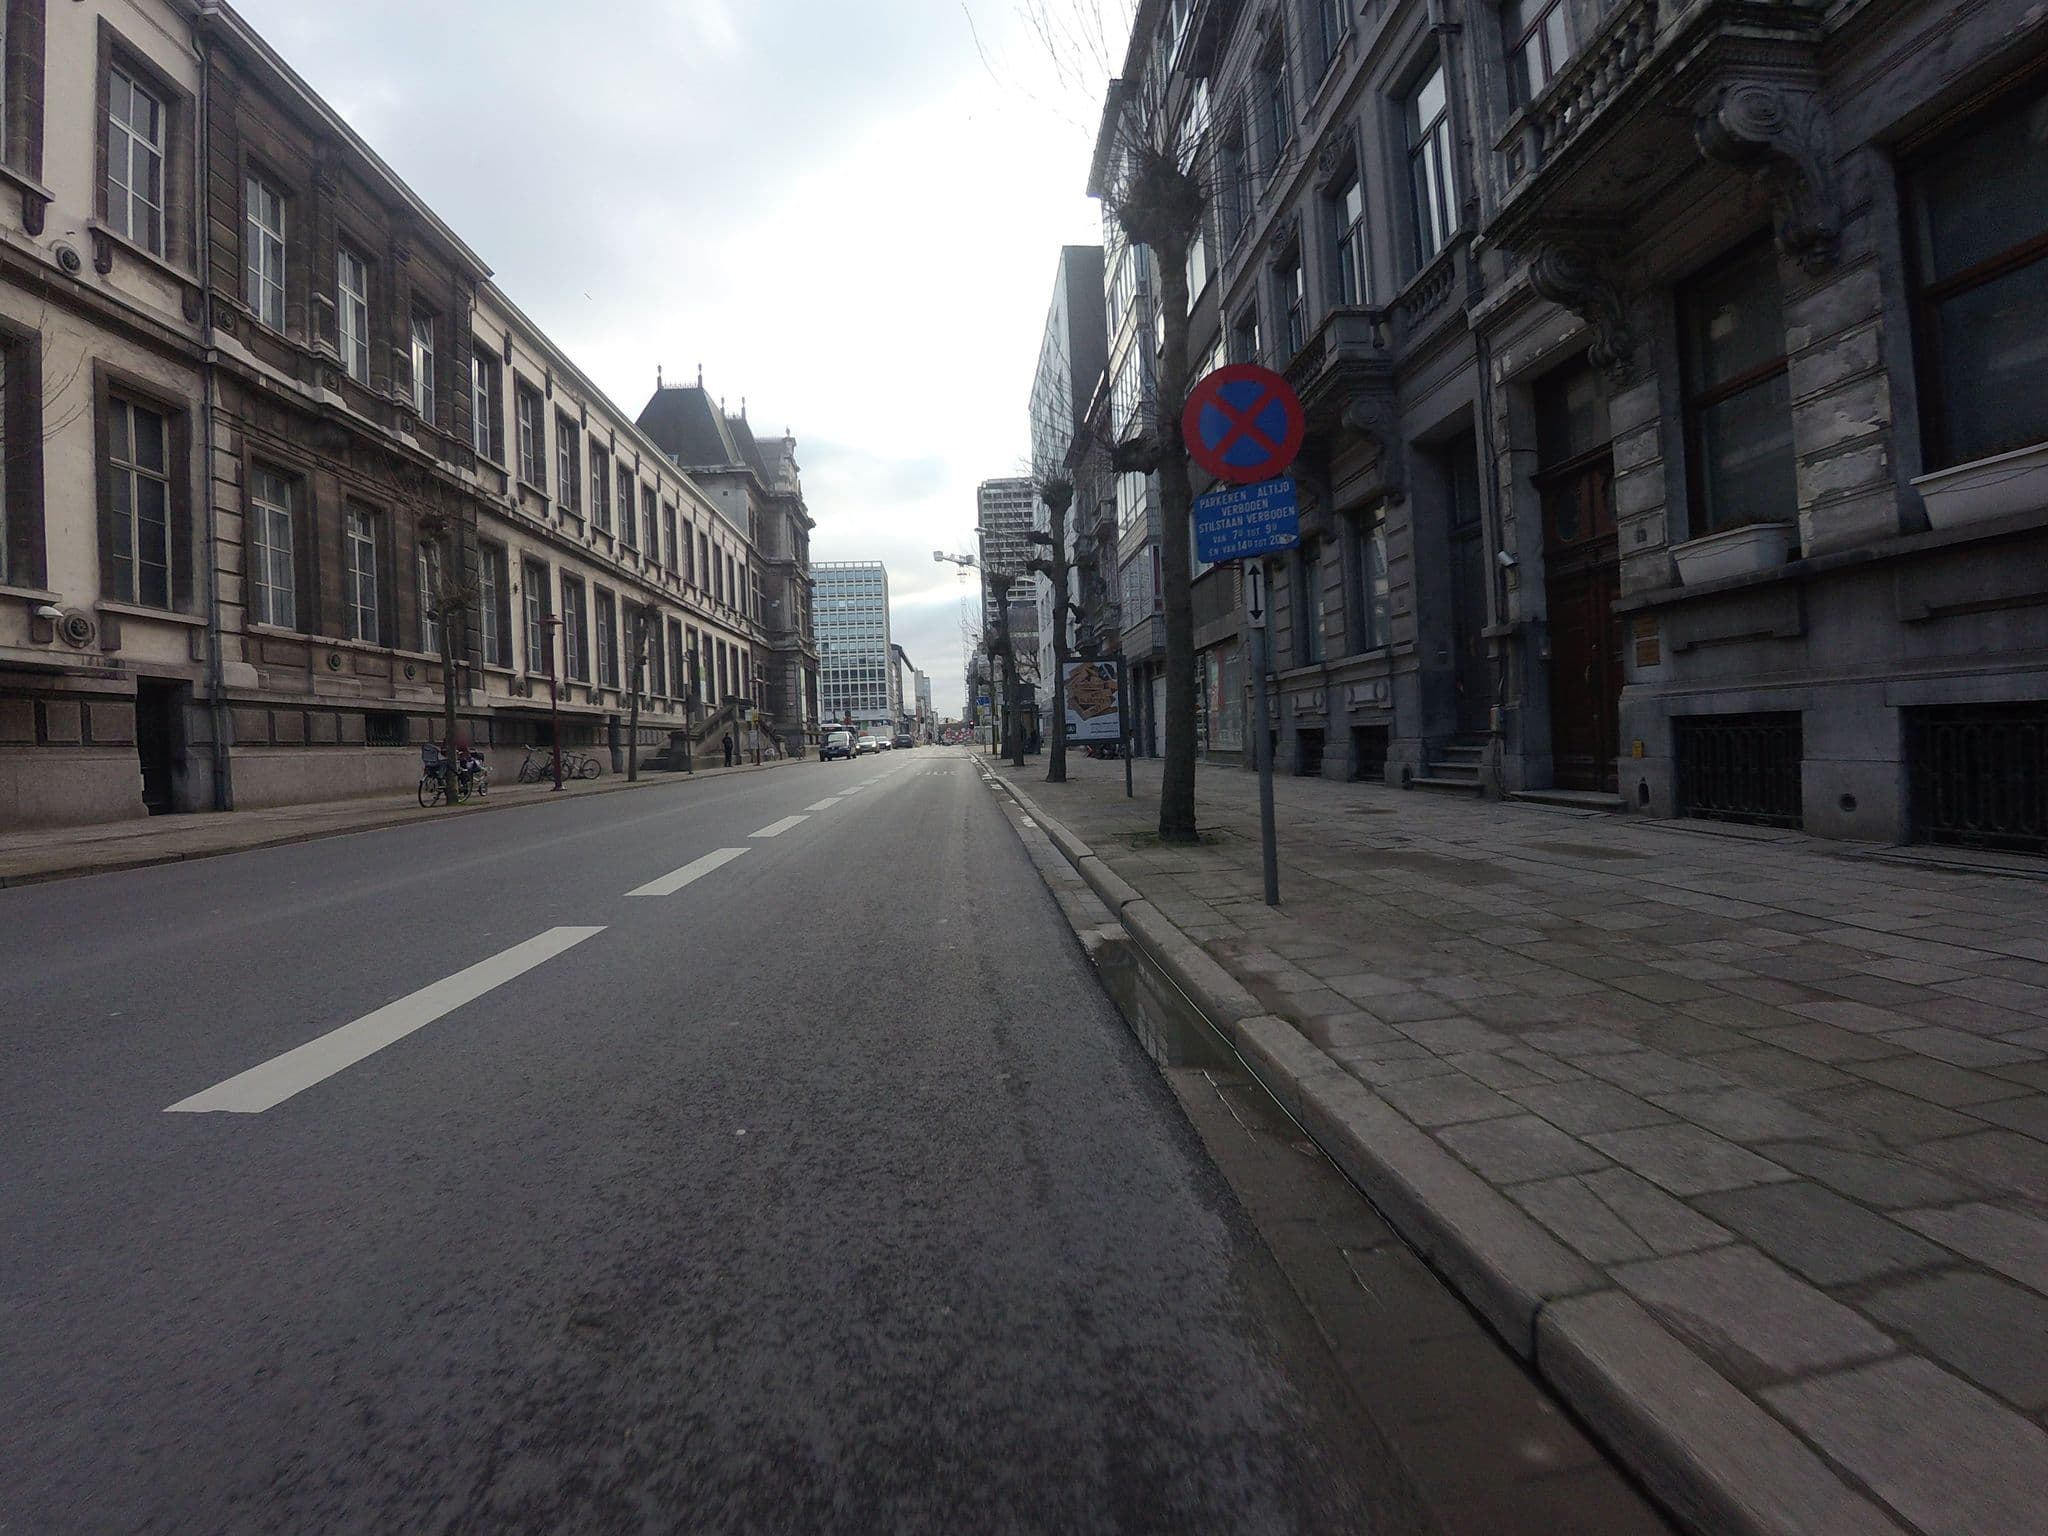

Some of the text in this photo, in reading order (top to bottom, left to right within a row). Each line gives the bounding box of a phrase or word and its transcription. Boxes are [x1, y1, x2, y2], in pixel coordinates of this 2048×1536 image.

[1199, 481, 1290, 510] PARKEREN ALTIJD
[1221, 498, 1269, 517] VERBODEN
[1199, 506, 1295, 533] STILSTAAN VERBODEN
